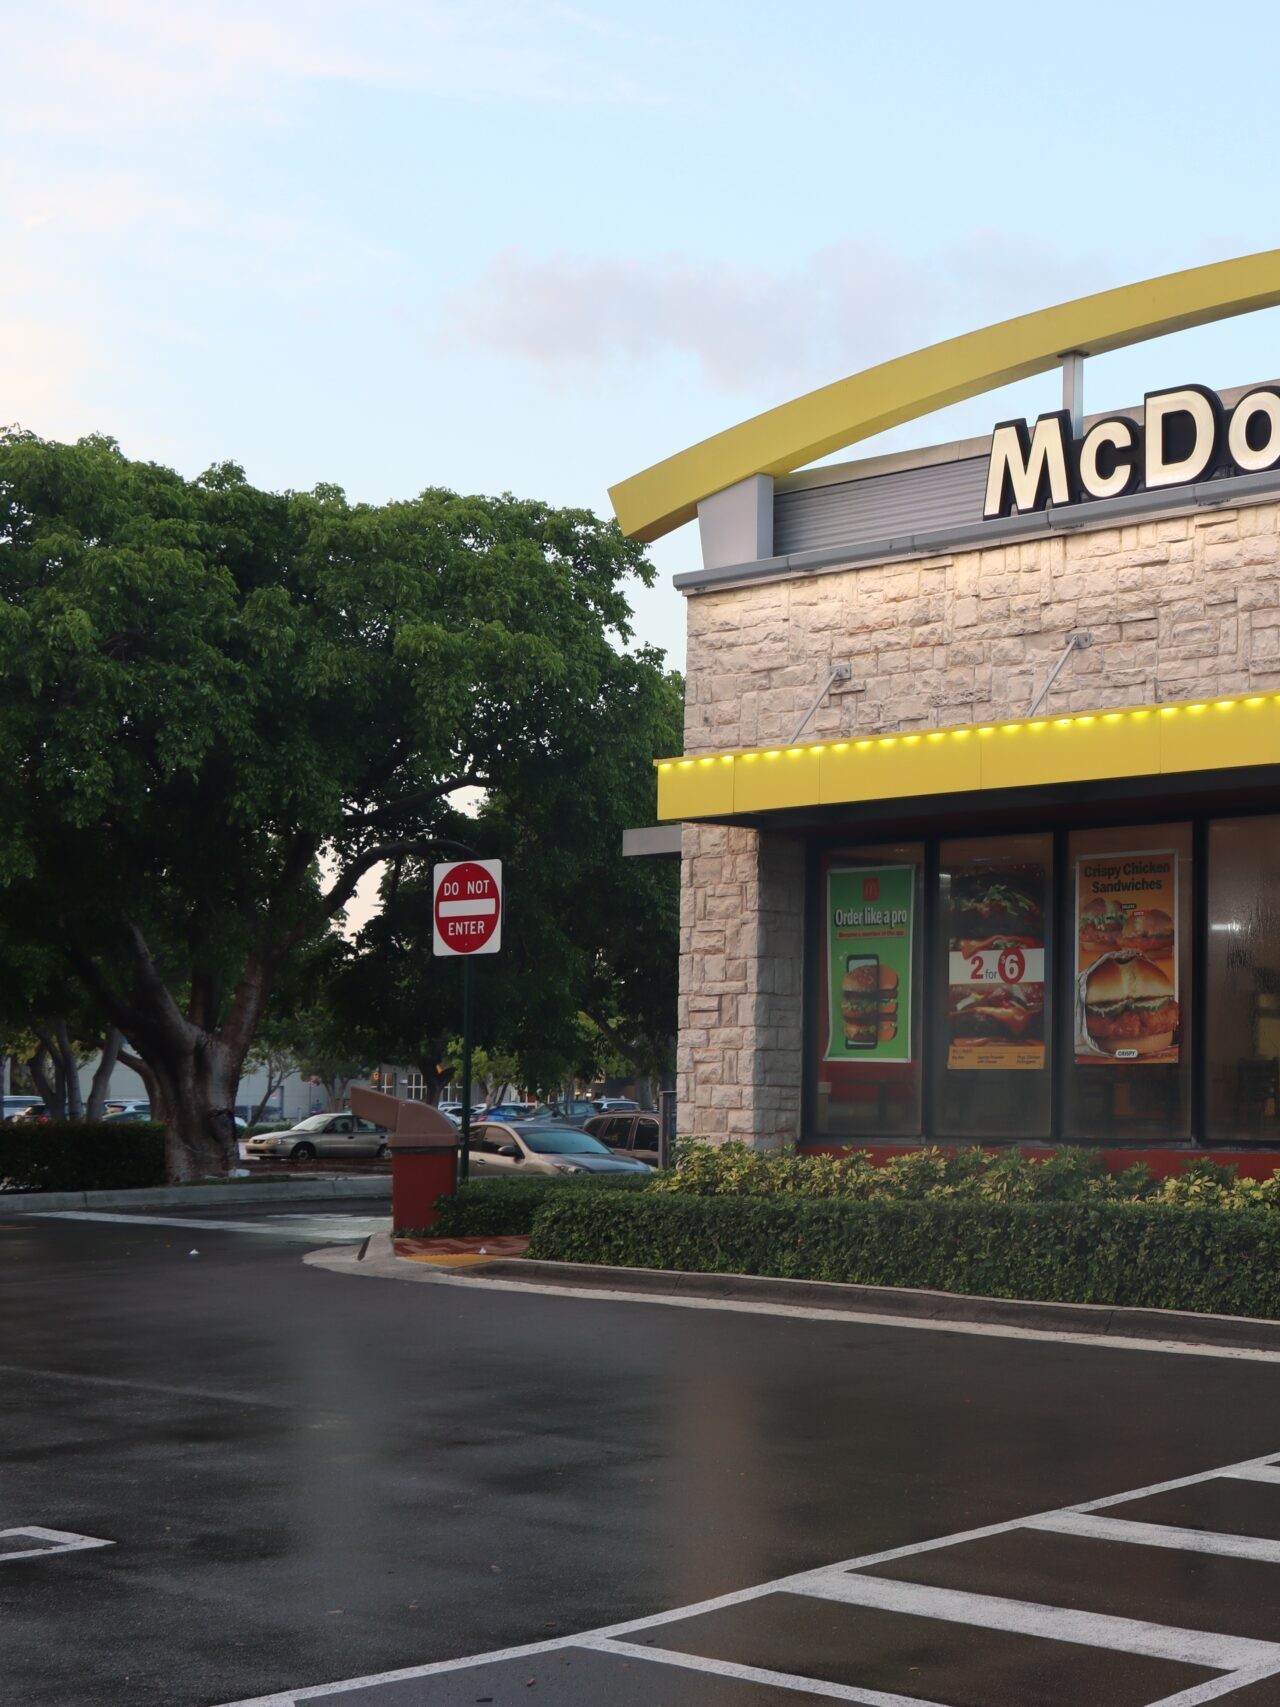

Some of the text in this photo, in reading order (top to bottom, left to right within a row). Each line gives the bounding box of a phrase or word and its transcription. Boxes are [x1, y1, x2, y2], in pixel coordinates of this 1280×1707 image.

[1084, 861, 1170, 880] Crispy Chicken
[444, 880, 490, 896] DO NOT
[1091, 878, 1163, 893] Sandwiches
[835, 906, 907, 928] Order like a pro
[448, 920, 485, 936] ENTER
[970, 955, 984, 980] 2
[985, 968, 998, 980] for
